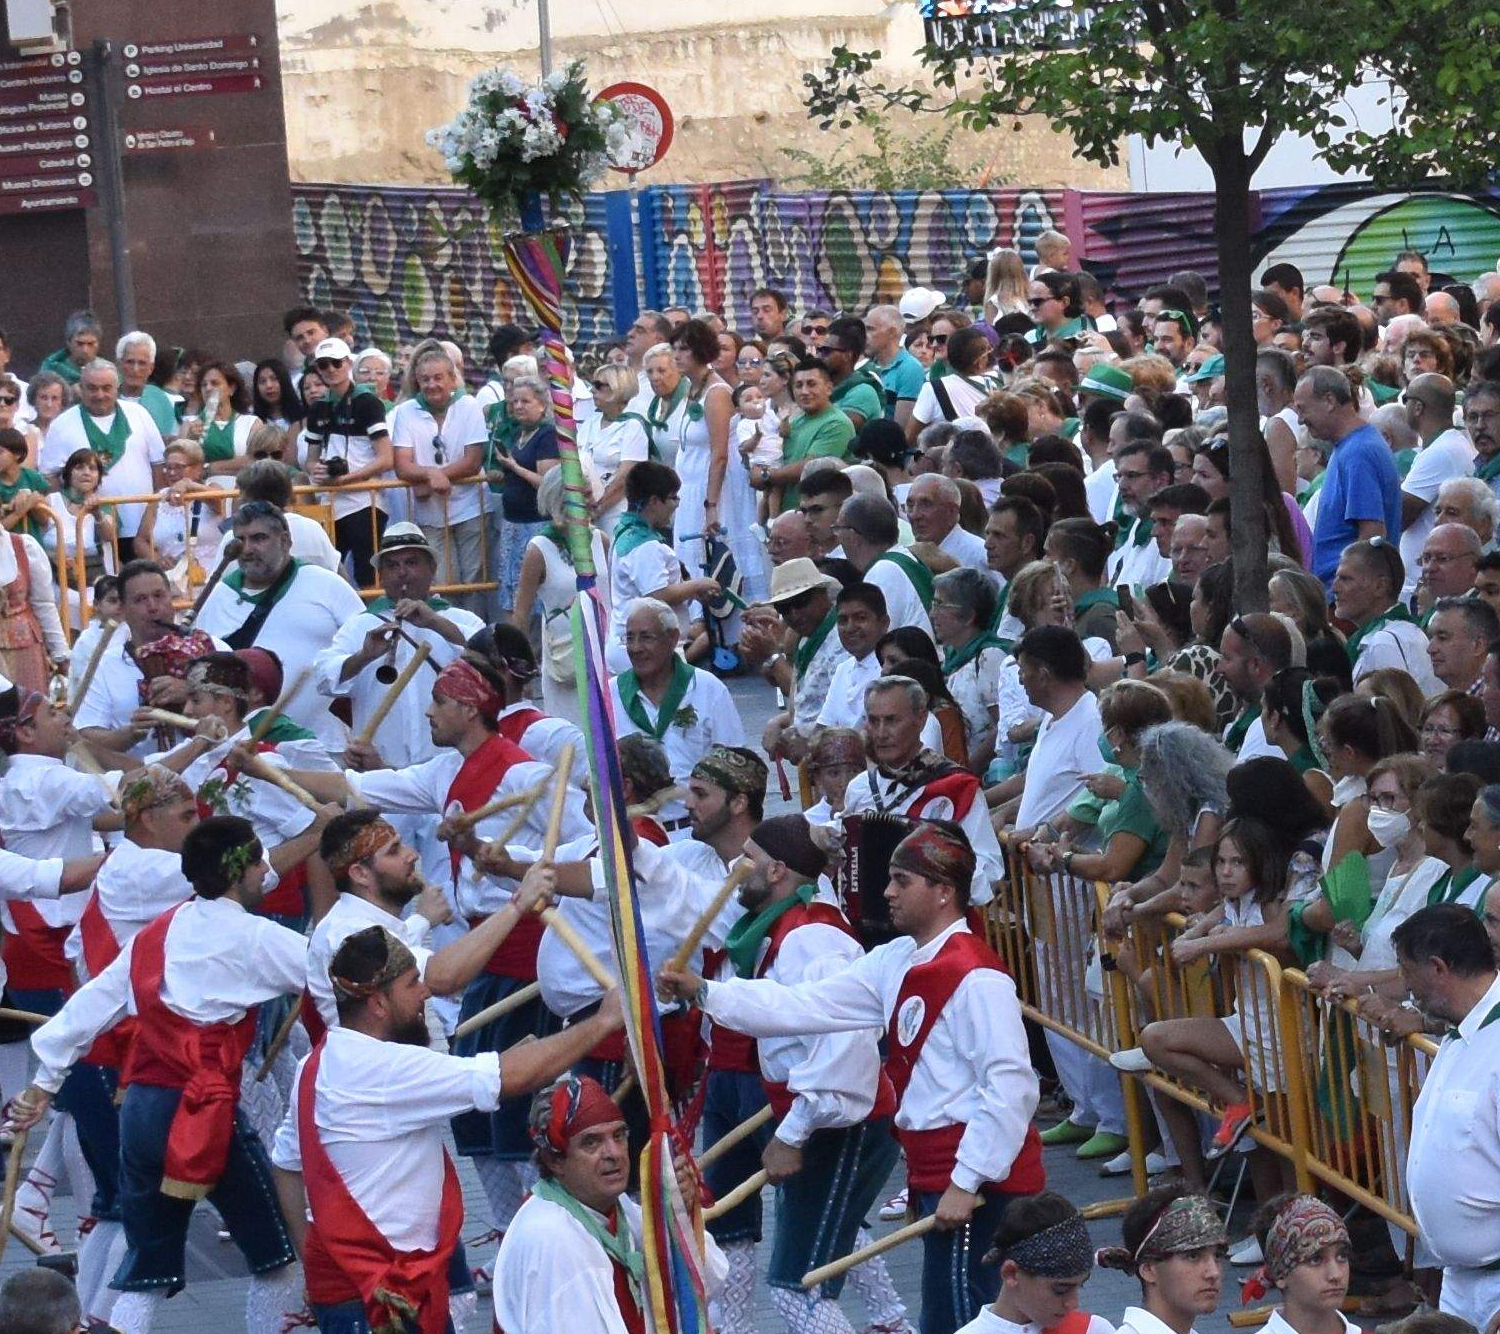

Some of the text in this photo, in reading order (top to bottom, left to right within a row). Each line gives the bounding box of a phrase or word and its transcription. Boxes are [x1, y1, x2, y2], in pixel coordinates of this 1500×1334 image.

[142, 40, 224, 54] Parking Universidad
[143, 61, 249, 75] Iglesia de Santo Domingo
[0, 79, 29, 88] Centro
[145, 86, 173, 95] Hostal
[183, 83, 213, 92] Centro
[39, 93, 68, 102] Museo
[25, 124, 36, 132] de
[37, 122, 70, 130] Turismo
[39, 158, 75, 168] Catedral
[2, 178, 77, 189] Museo Diocesano
[21, 197, 79, 208] Ayuntamiento
[1402, 226, 1456, 257] LA
[851, 847, 859, 893] ESTRELLA
